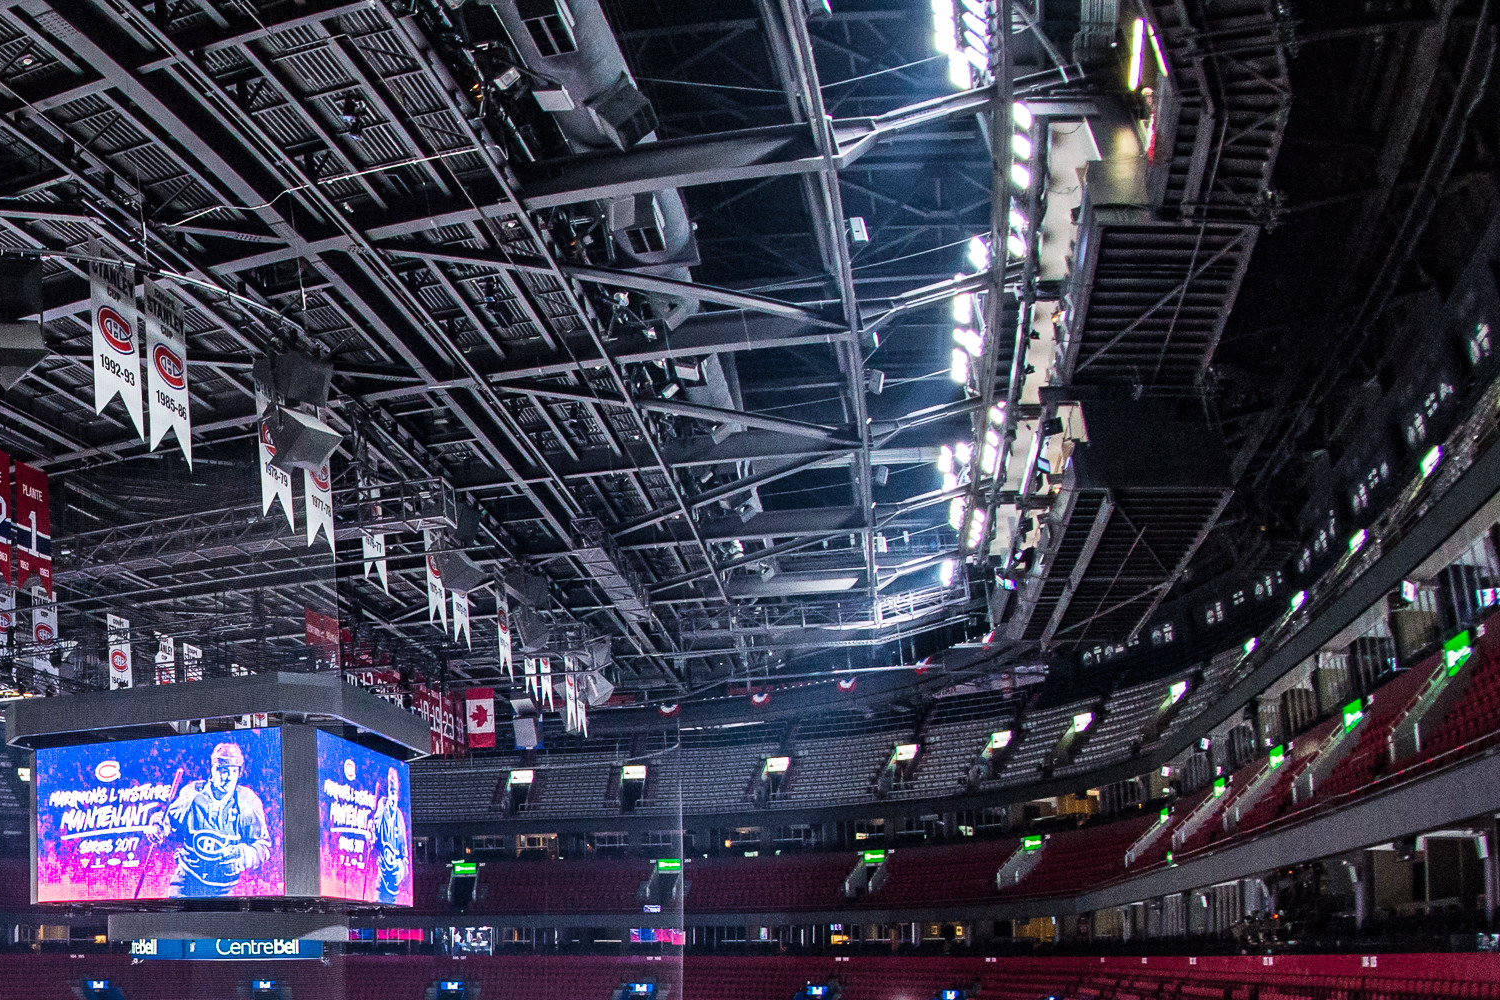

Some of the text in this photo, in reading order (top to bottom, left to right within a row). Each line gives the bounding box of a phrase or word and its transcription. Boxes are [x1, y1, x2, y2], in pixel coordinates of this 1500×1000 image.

[100, 354, 135, 386] 1992-93
[156, 390, 187, 420] 1985-86
[22, 484, 43, 502] PLANTE
[28, 510, 40, 557] 1
[216, 938, 299, 955] CentreBell
